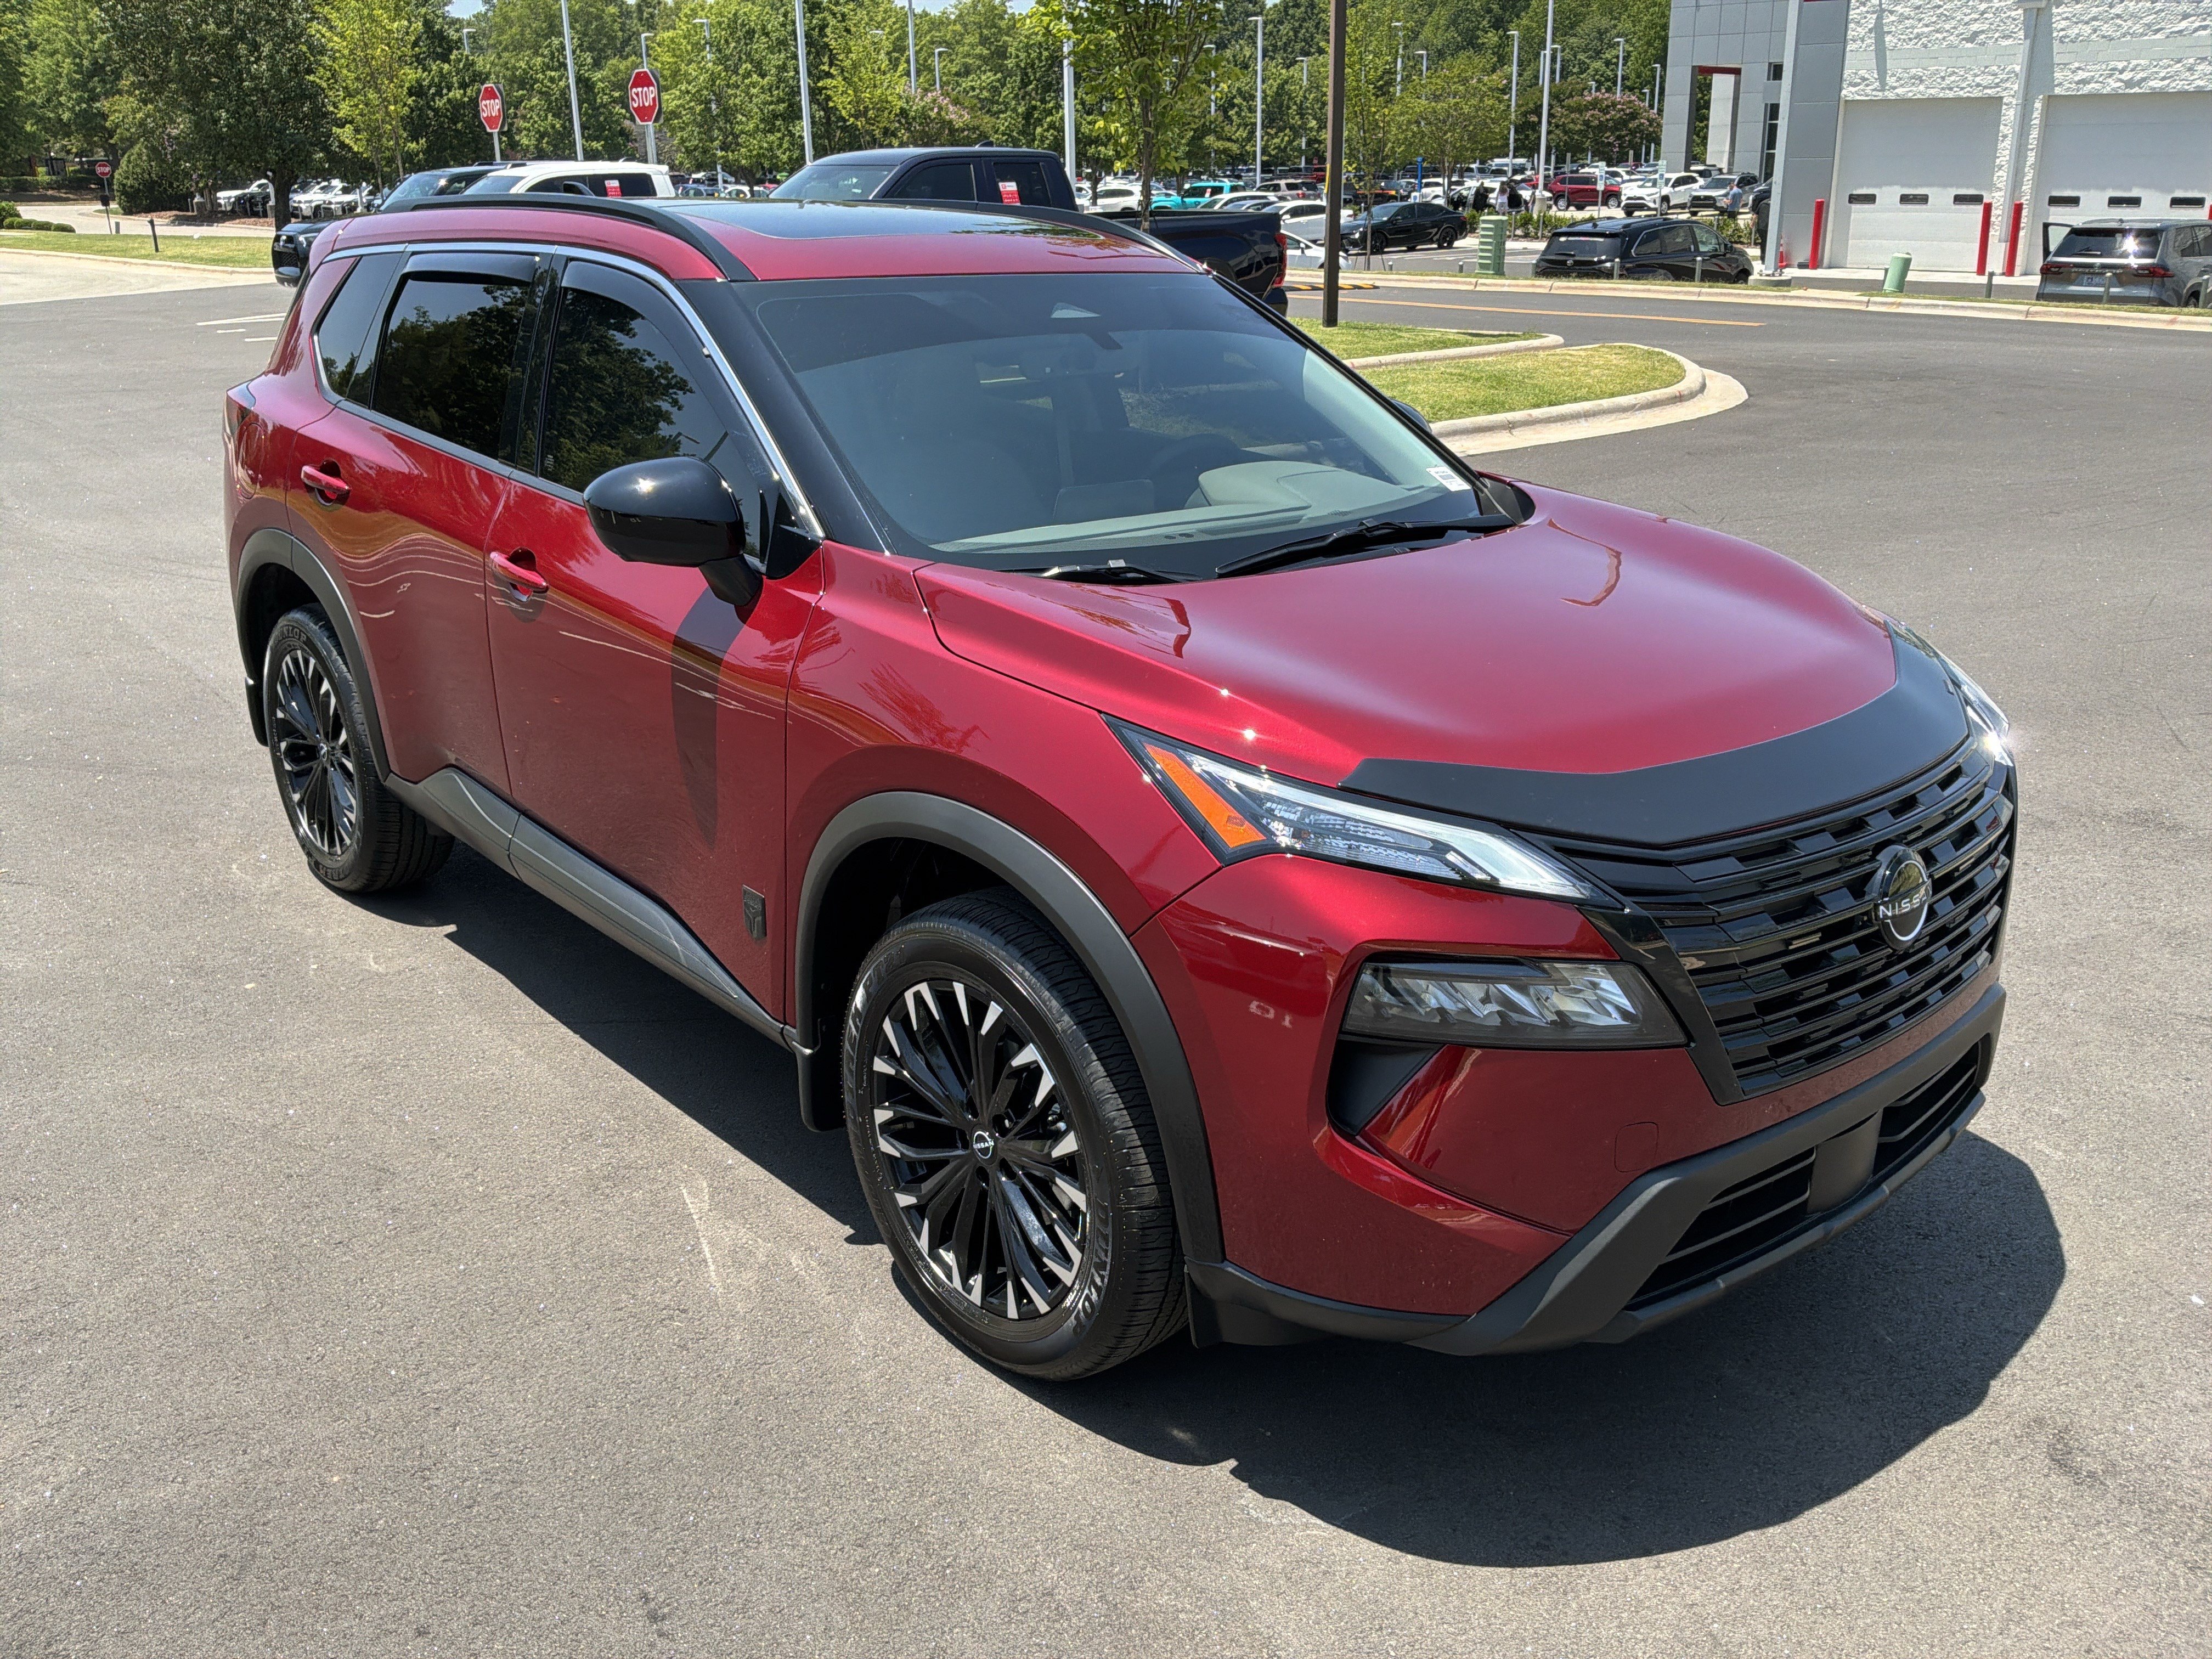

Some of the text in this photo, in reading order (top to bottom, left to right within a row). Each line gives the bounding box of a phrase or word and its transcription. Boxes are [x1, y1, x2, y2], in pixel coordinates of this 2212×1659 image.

[631, 86, 655, 108] STOP
[482, 99, 500, 117] STOP
[973, 1140, 994, 1149] NISSAN
[1073, 1198, 1110, 1338] DUNLOP
